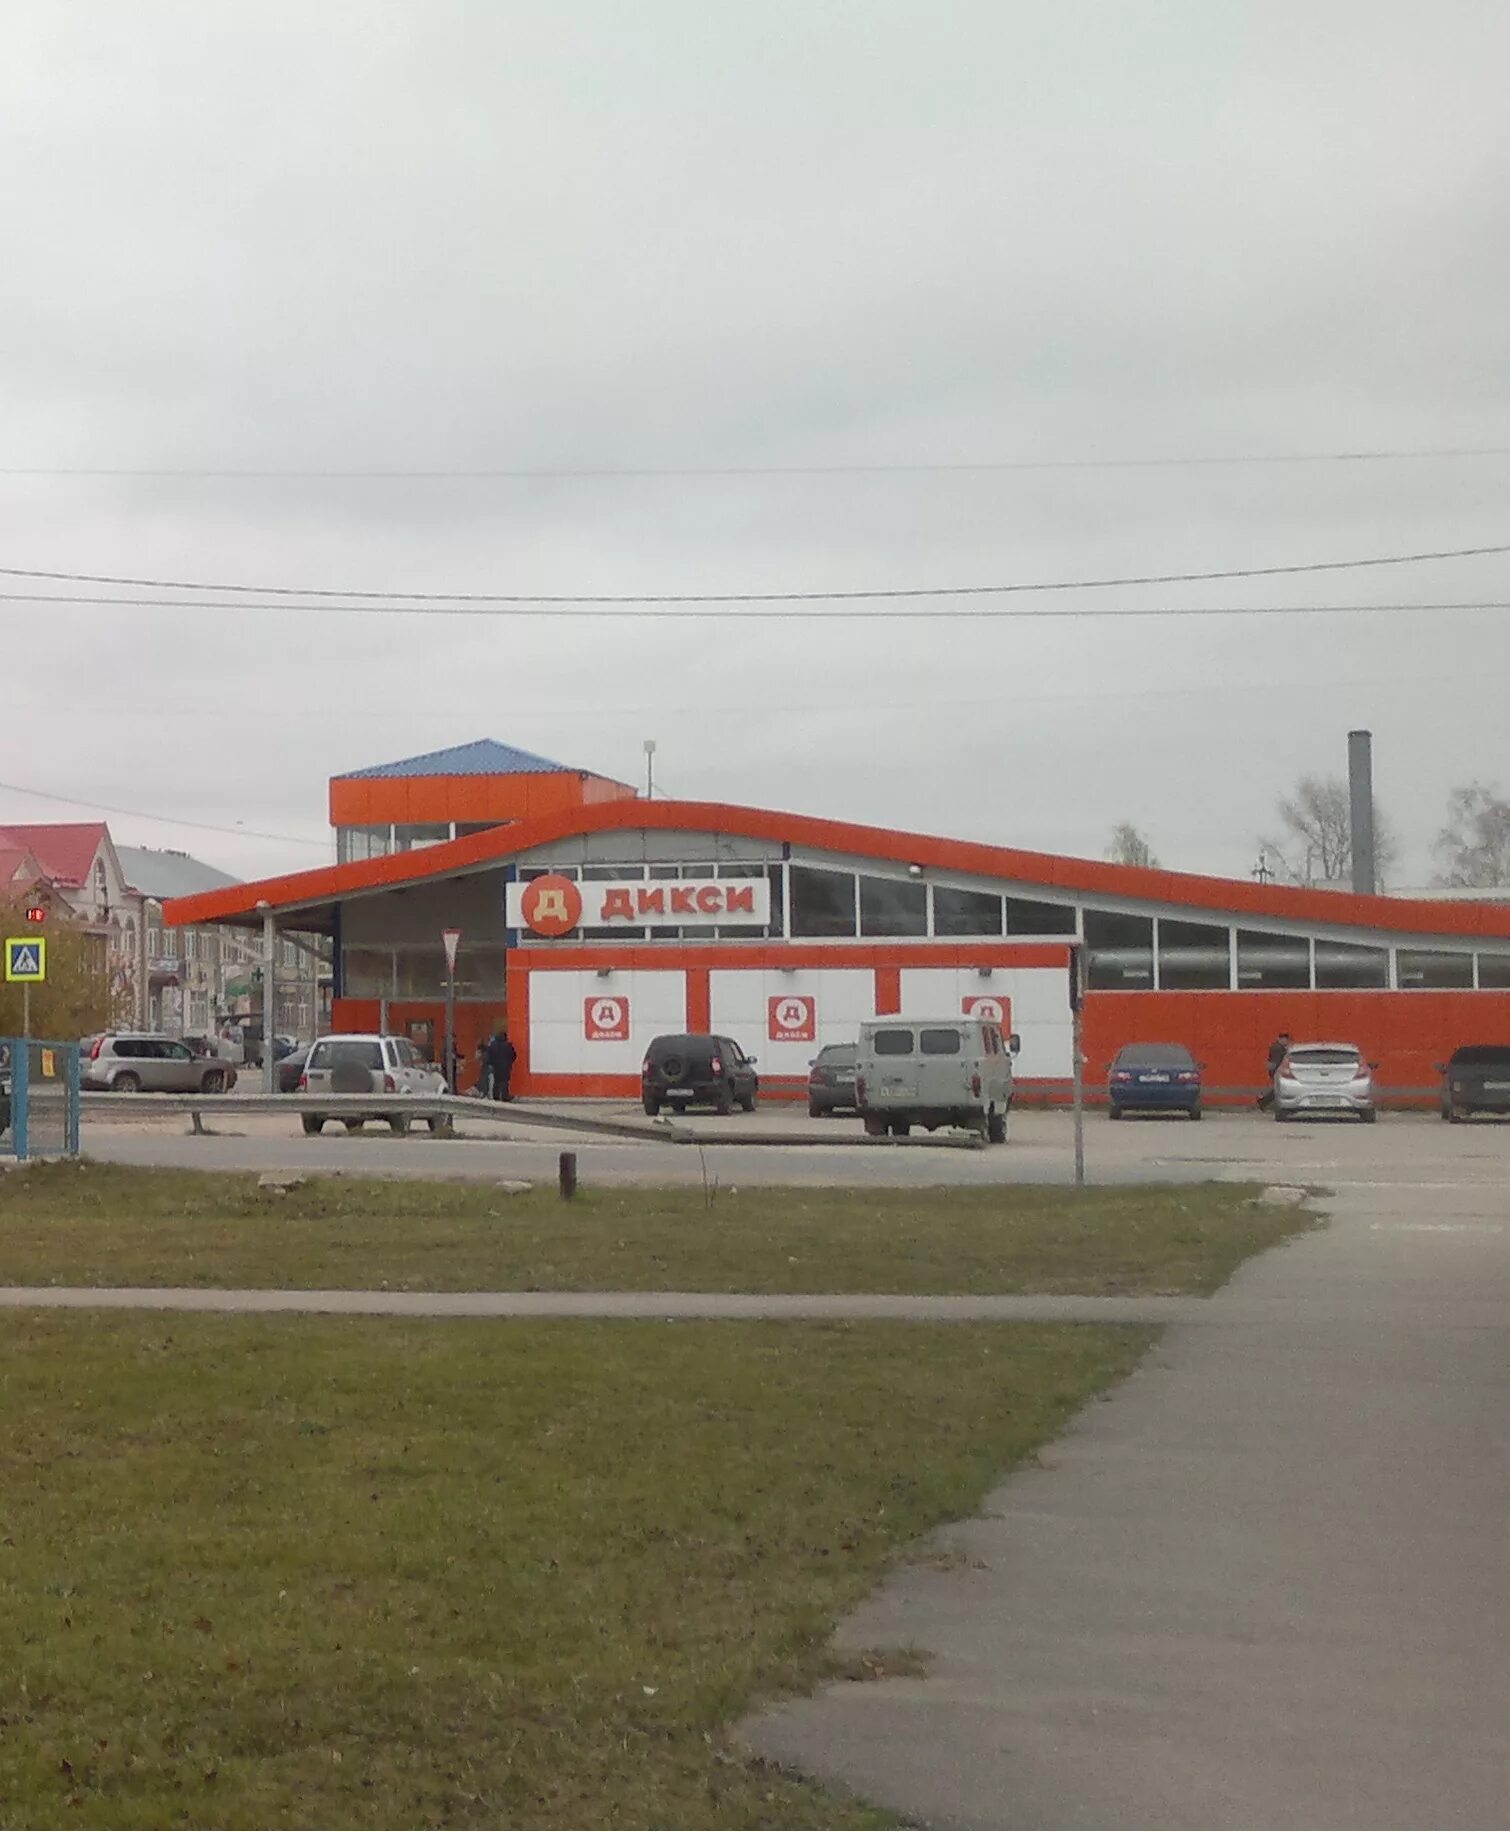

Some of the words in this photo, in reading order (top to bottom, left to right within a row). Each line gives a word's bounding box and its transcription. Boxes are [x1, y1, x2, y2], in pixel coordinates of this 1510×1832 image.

[532, 889, 568, 922] Д
[600, 885, 755, 922] ДИКСИ
[598, 1005, 615, 1021] Д
[783, 1005, 800, 1021] Д
